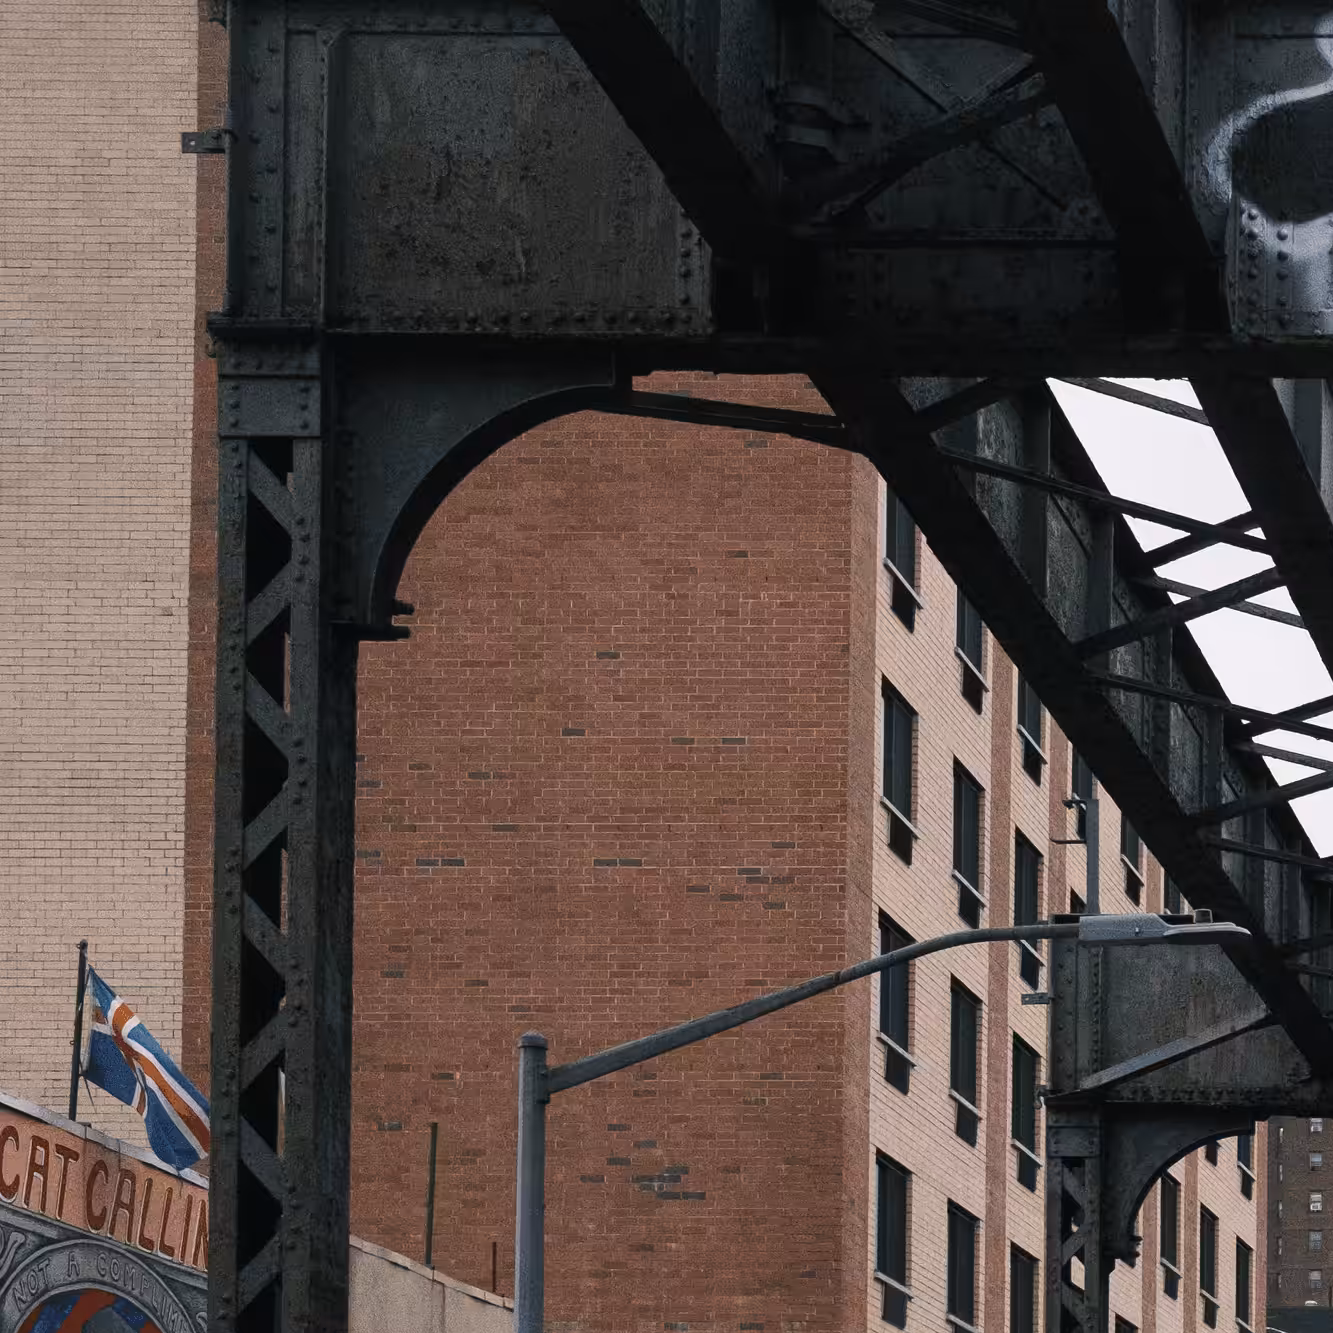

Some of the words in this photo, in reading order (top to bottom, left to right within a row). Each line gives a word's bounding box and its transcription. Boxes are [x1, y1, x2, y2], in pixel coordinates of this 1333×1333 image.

[0, 1125, 80, 1220] CAT
[13, 1258, 51, 1313] NOT
[67, 1251, 81, 1278] A
